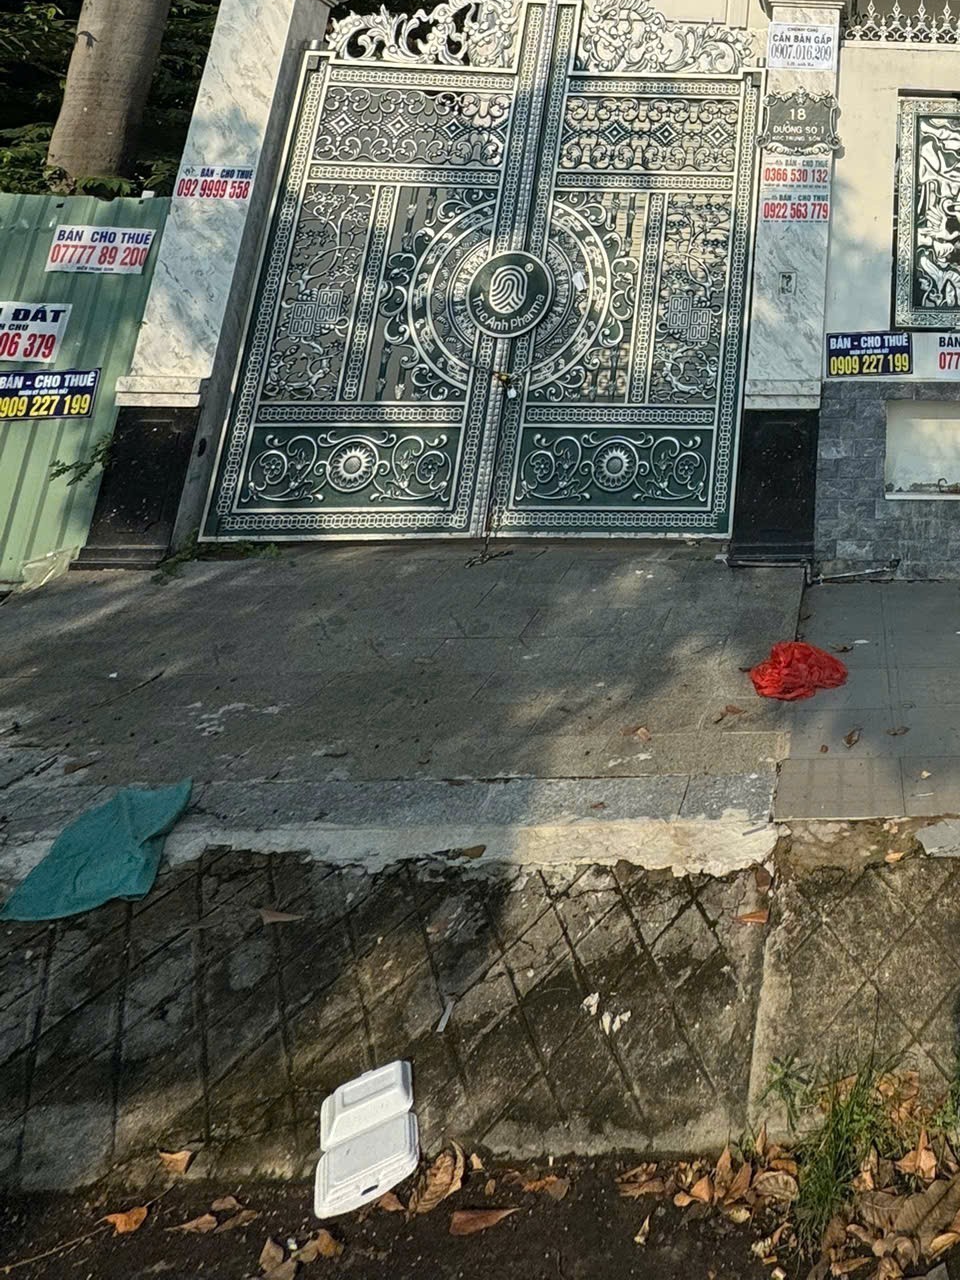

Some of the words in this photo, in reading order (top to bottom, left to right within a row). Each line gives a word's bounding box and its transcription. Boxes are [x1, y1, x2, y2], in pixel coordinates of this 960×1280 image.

[790, 108, 807, 121] 18
[820, 126, 824, 134] 1
[220, 168, 235, 178] CHO
[765, 167, 788, 182] 0366
[790, 168, 808, 183] 530
[811, 169, 828, 183] 132
[177, 178, 199, 197] 092
[199, 179, 228, 198] 9999
[229, 180, 251, 199] 558
[763, 202, 788, 219] 0922
[790, 202, 808, 219] 563
[811, 202, 829, 219] 779
[57, 228, 84, 241] BÁN
[90, 231, 117, 244] CHO
[120, 231, 152, 245] THUÊ
[50, 244, 97, 264] 07777
[98, 246, 118, 265] 89
[120, 247, 148, 267] 200
[11, 305, 66, 323] ĐẤT
[484, 315, 509, 331] Anh
[510, 294, 545, 330] Pharma
[22, 333, 57, 359] 379
[830, 336, 851, 349] BÁN
[860, 335, 881, 348] CHO
[882, 333, 909, 347] THUÊ
[830, 355, 860, 375] 0909
[862, 354, 884, 373] 227
[887, 353, 909, 372] 199
[34, 374, 61, 388] CHO
[63, 371, 96, 387] THUÊ
[29, 395, 60, 416] 227
[63, 394, 91, 415] 199
